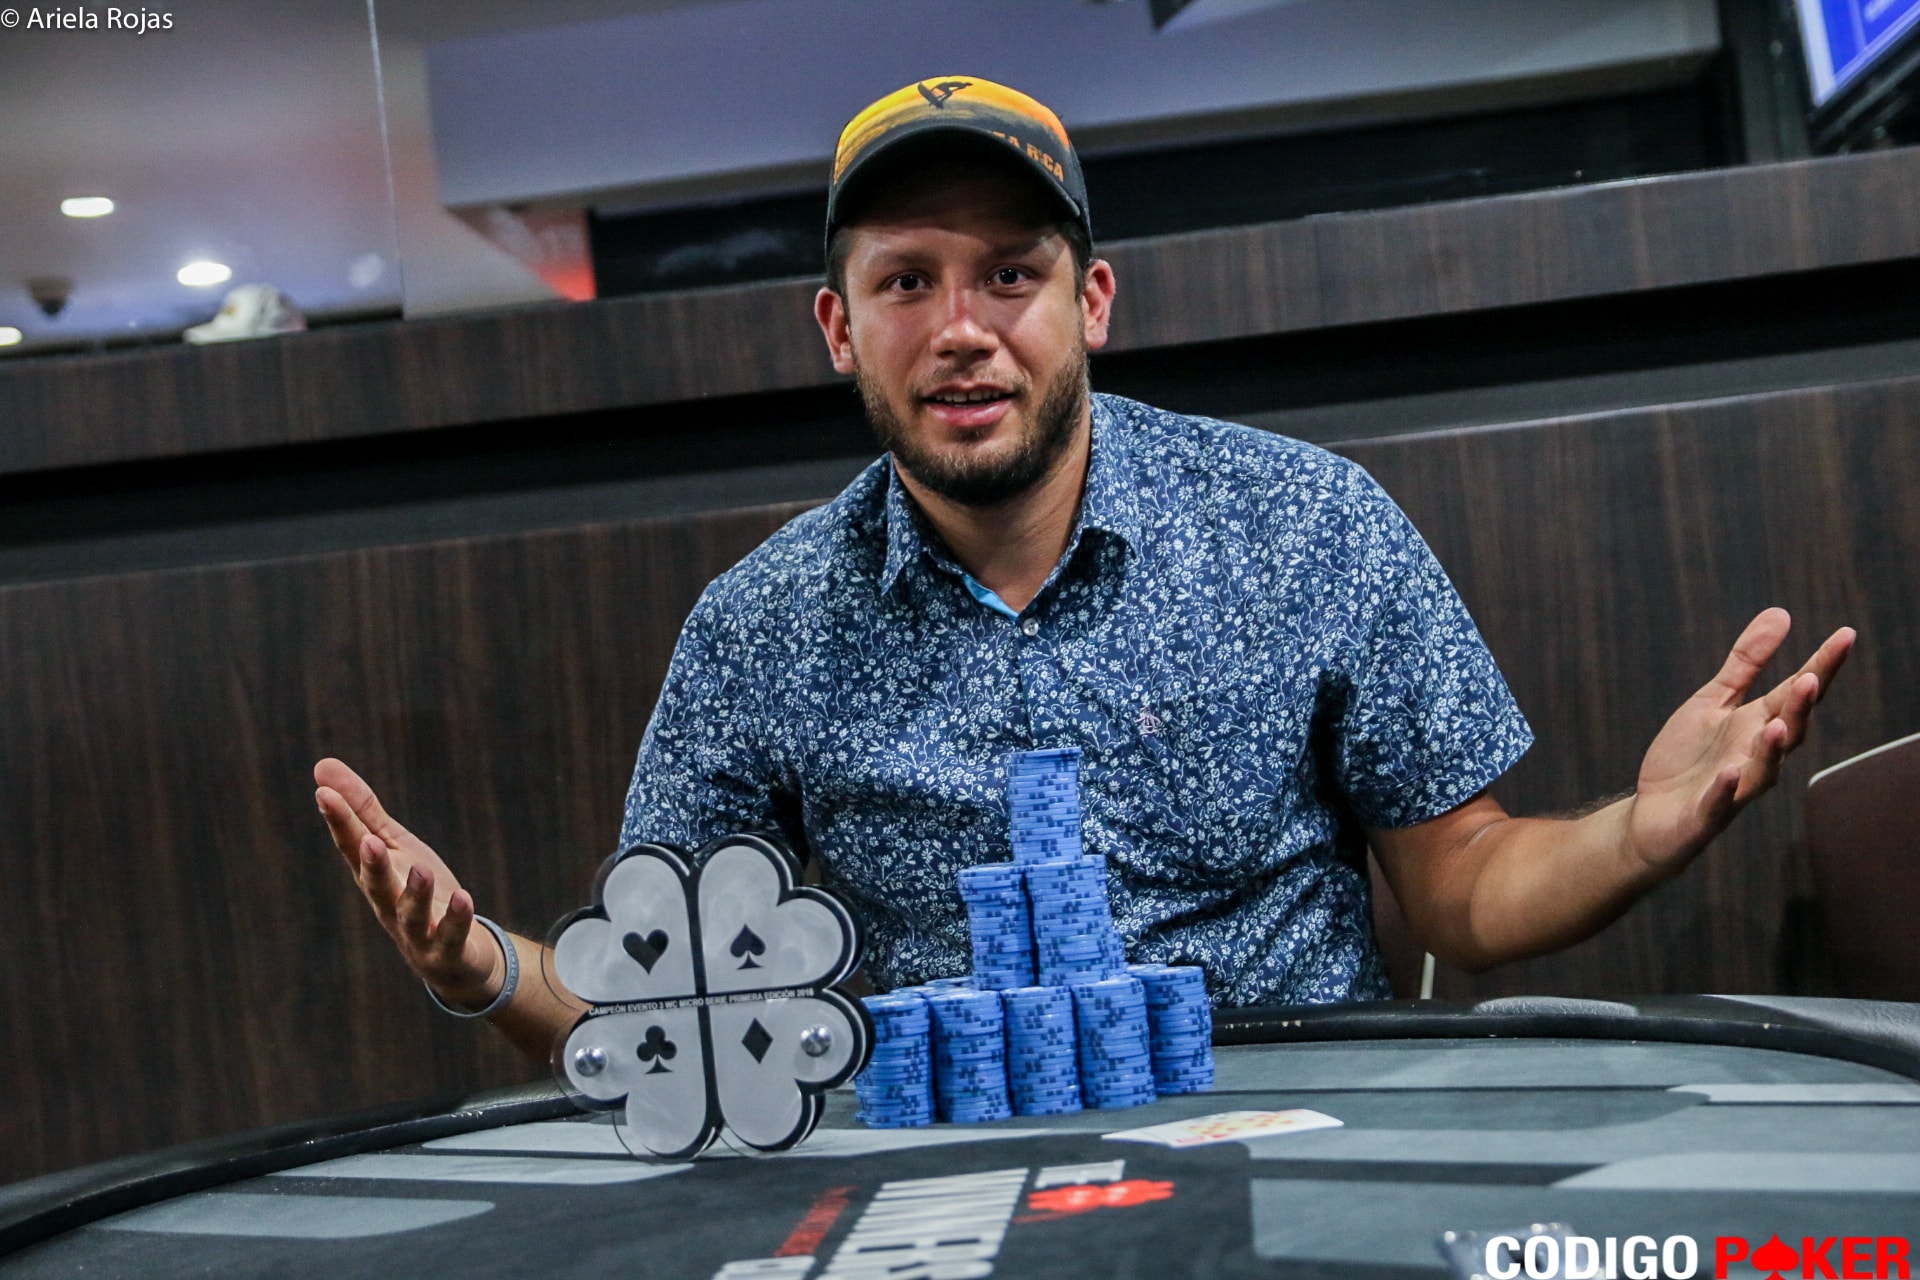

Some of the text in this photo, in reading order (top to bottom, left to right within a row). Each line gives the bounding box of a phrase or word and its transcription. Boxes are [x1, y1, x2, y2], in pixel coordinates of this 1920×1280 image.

[589, 1003, 626, 1015] CAMPEÓN
[627, 1003, 658, 1012] EVENTO
[665, 1000, 678, 1009] WC
[679, 998, 704, 1008] MICRO
[705, 996, 727, 1005] SERIE
[728, 993, 763, 1003] PRIMERA
[764, 988, 796, 1000] EDICIÓN
